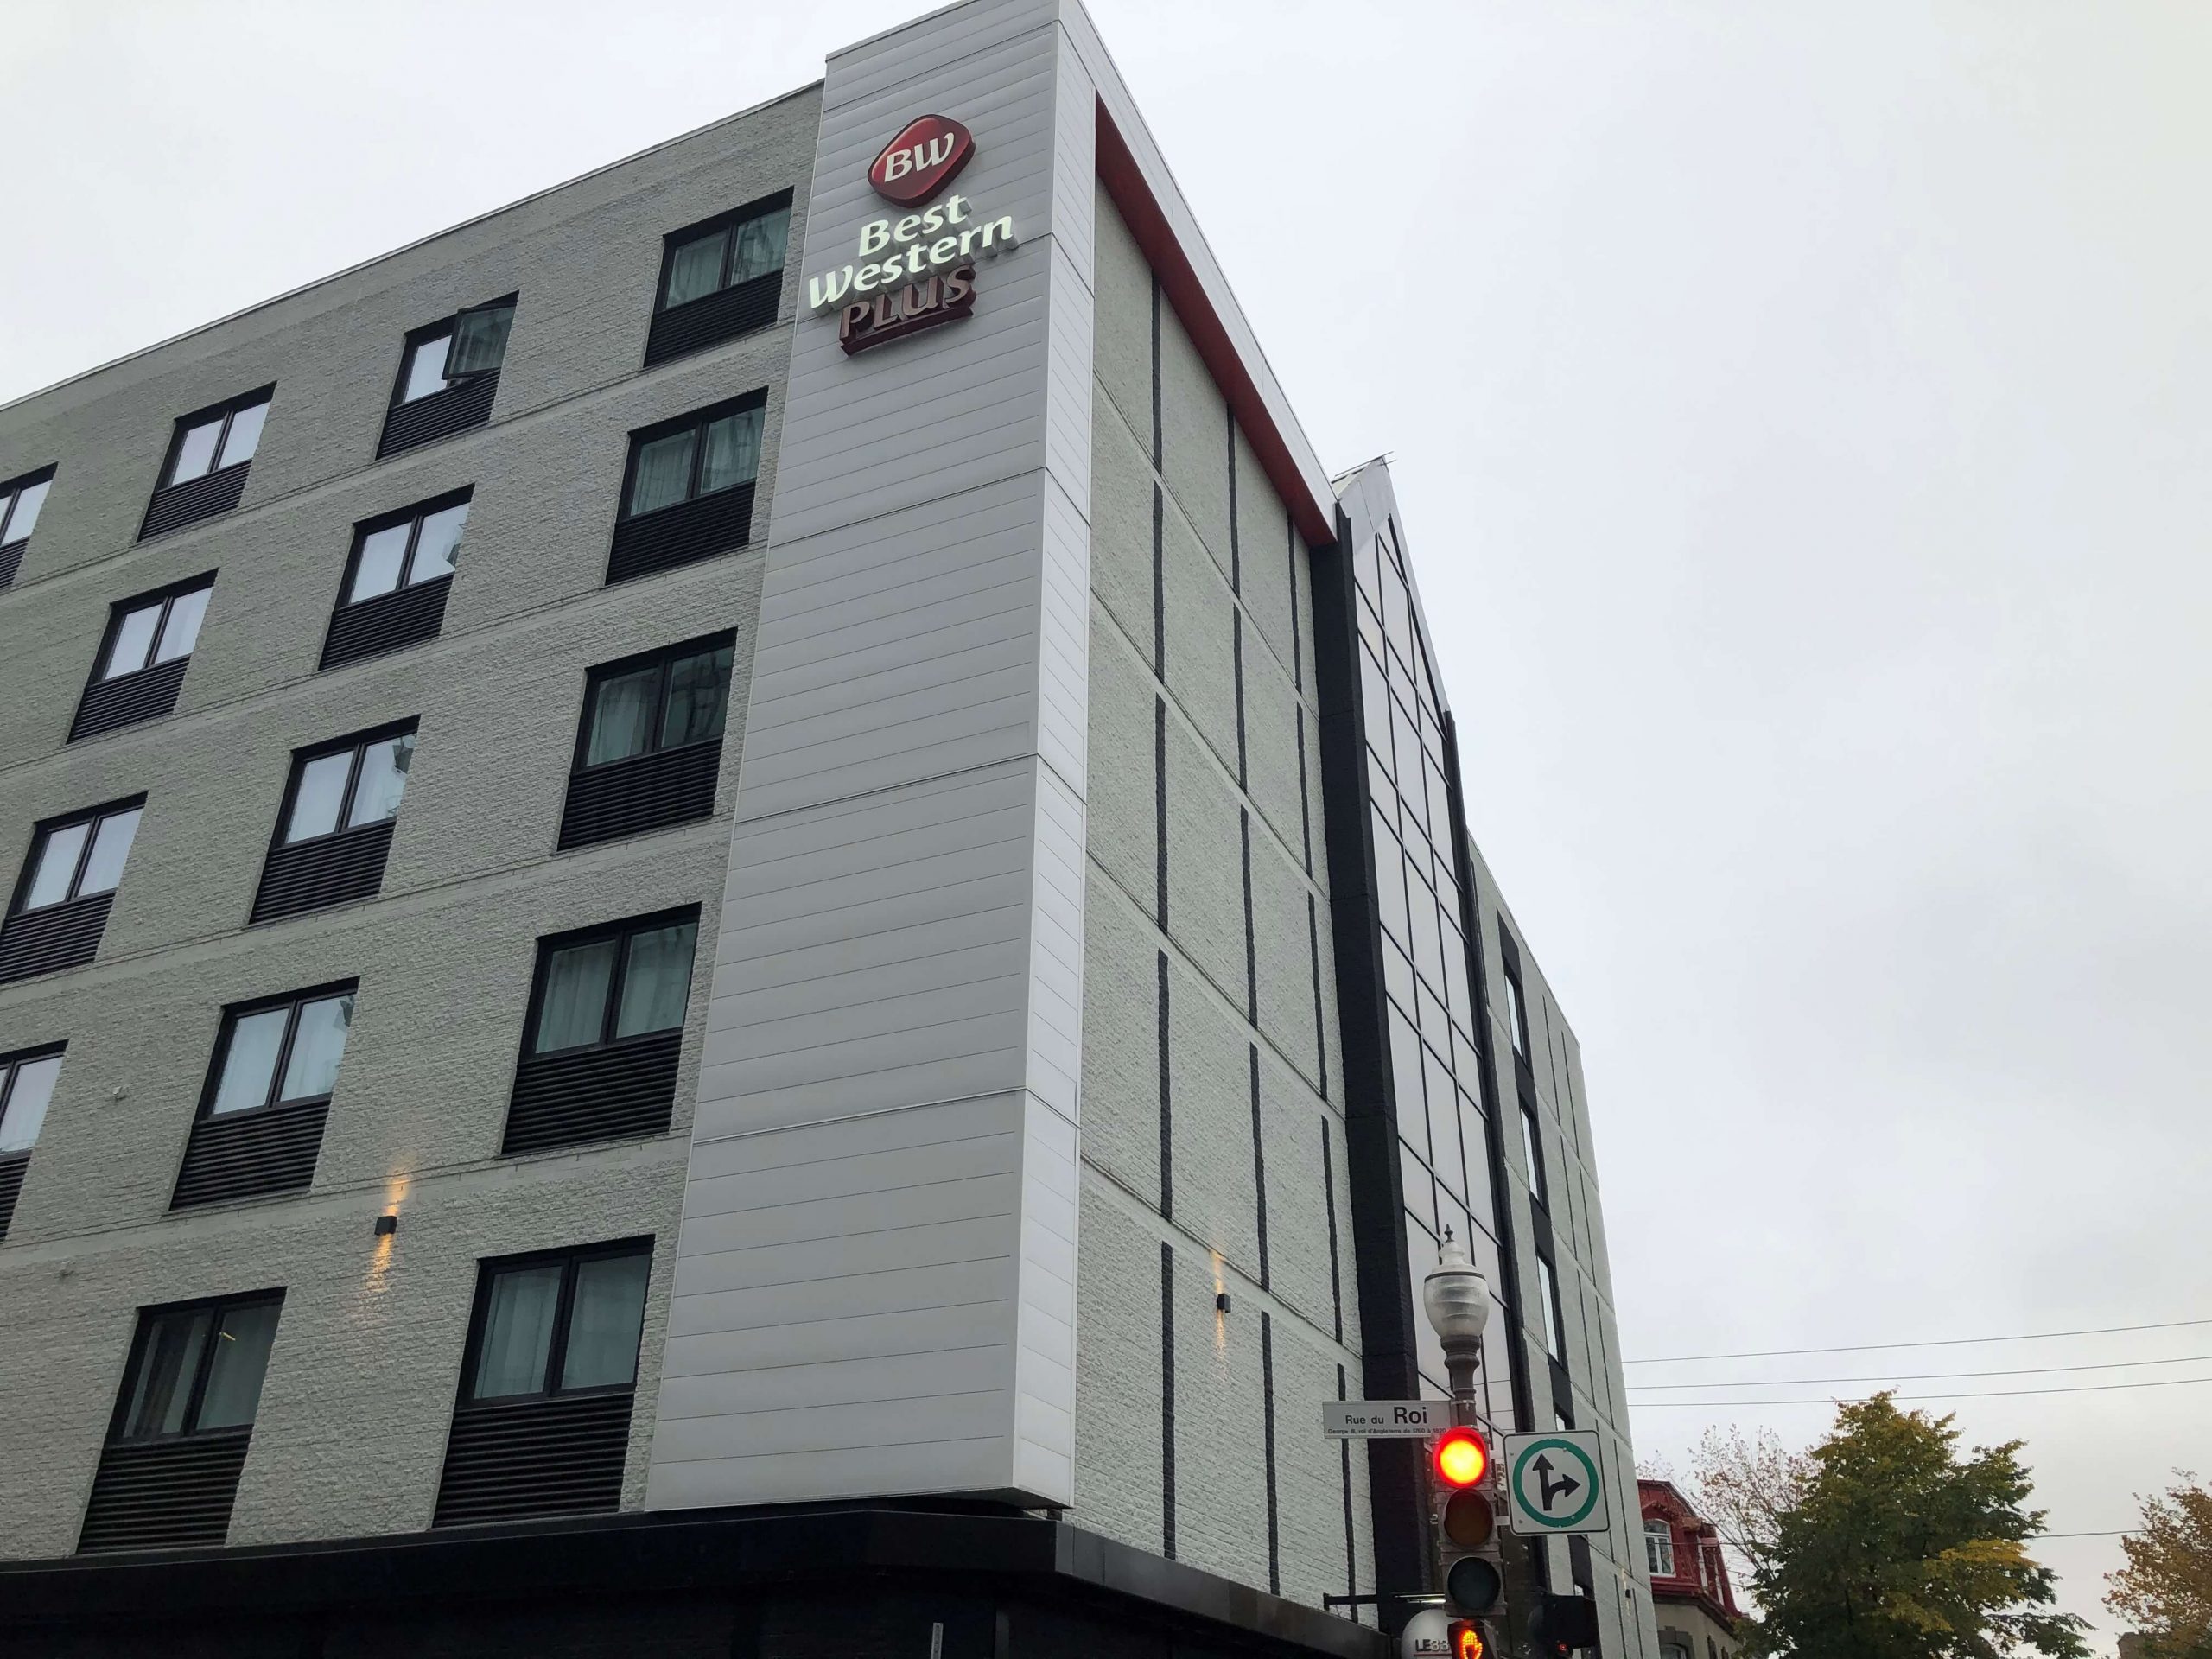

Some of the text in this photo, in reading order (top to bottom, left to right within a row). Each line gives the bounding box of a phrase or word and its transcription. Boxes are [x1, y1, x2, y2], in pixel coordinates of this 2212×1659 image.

[884, 132, 955, 182] BW
[859, 194, 969, 257] Best
[809, 216, 1014, 309] Western
[839, 265, 973, 340] PLUS
[1345, 1407, 1427, 1424] Rue du Roi
